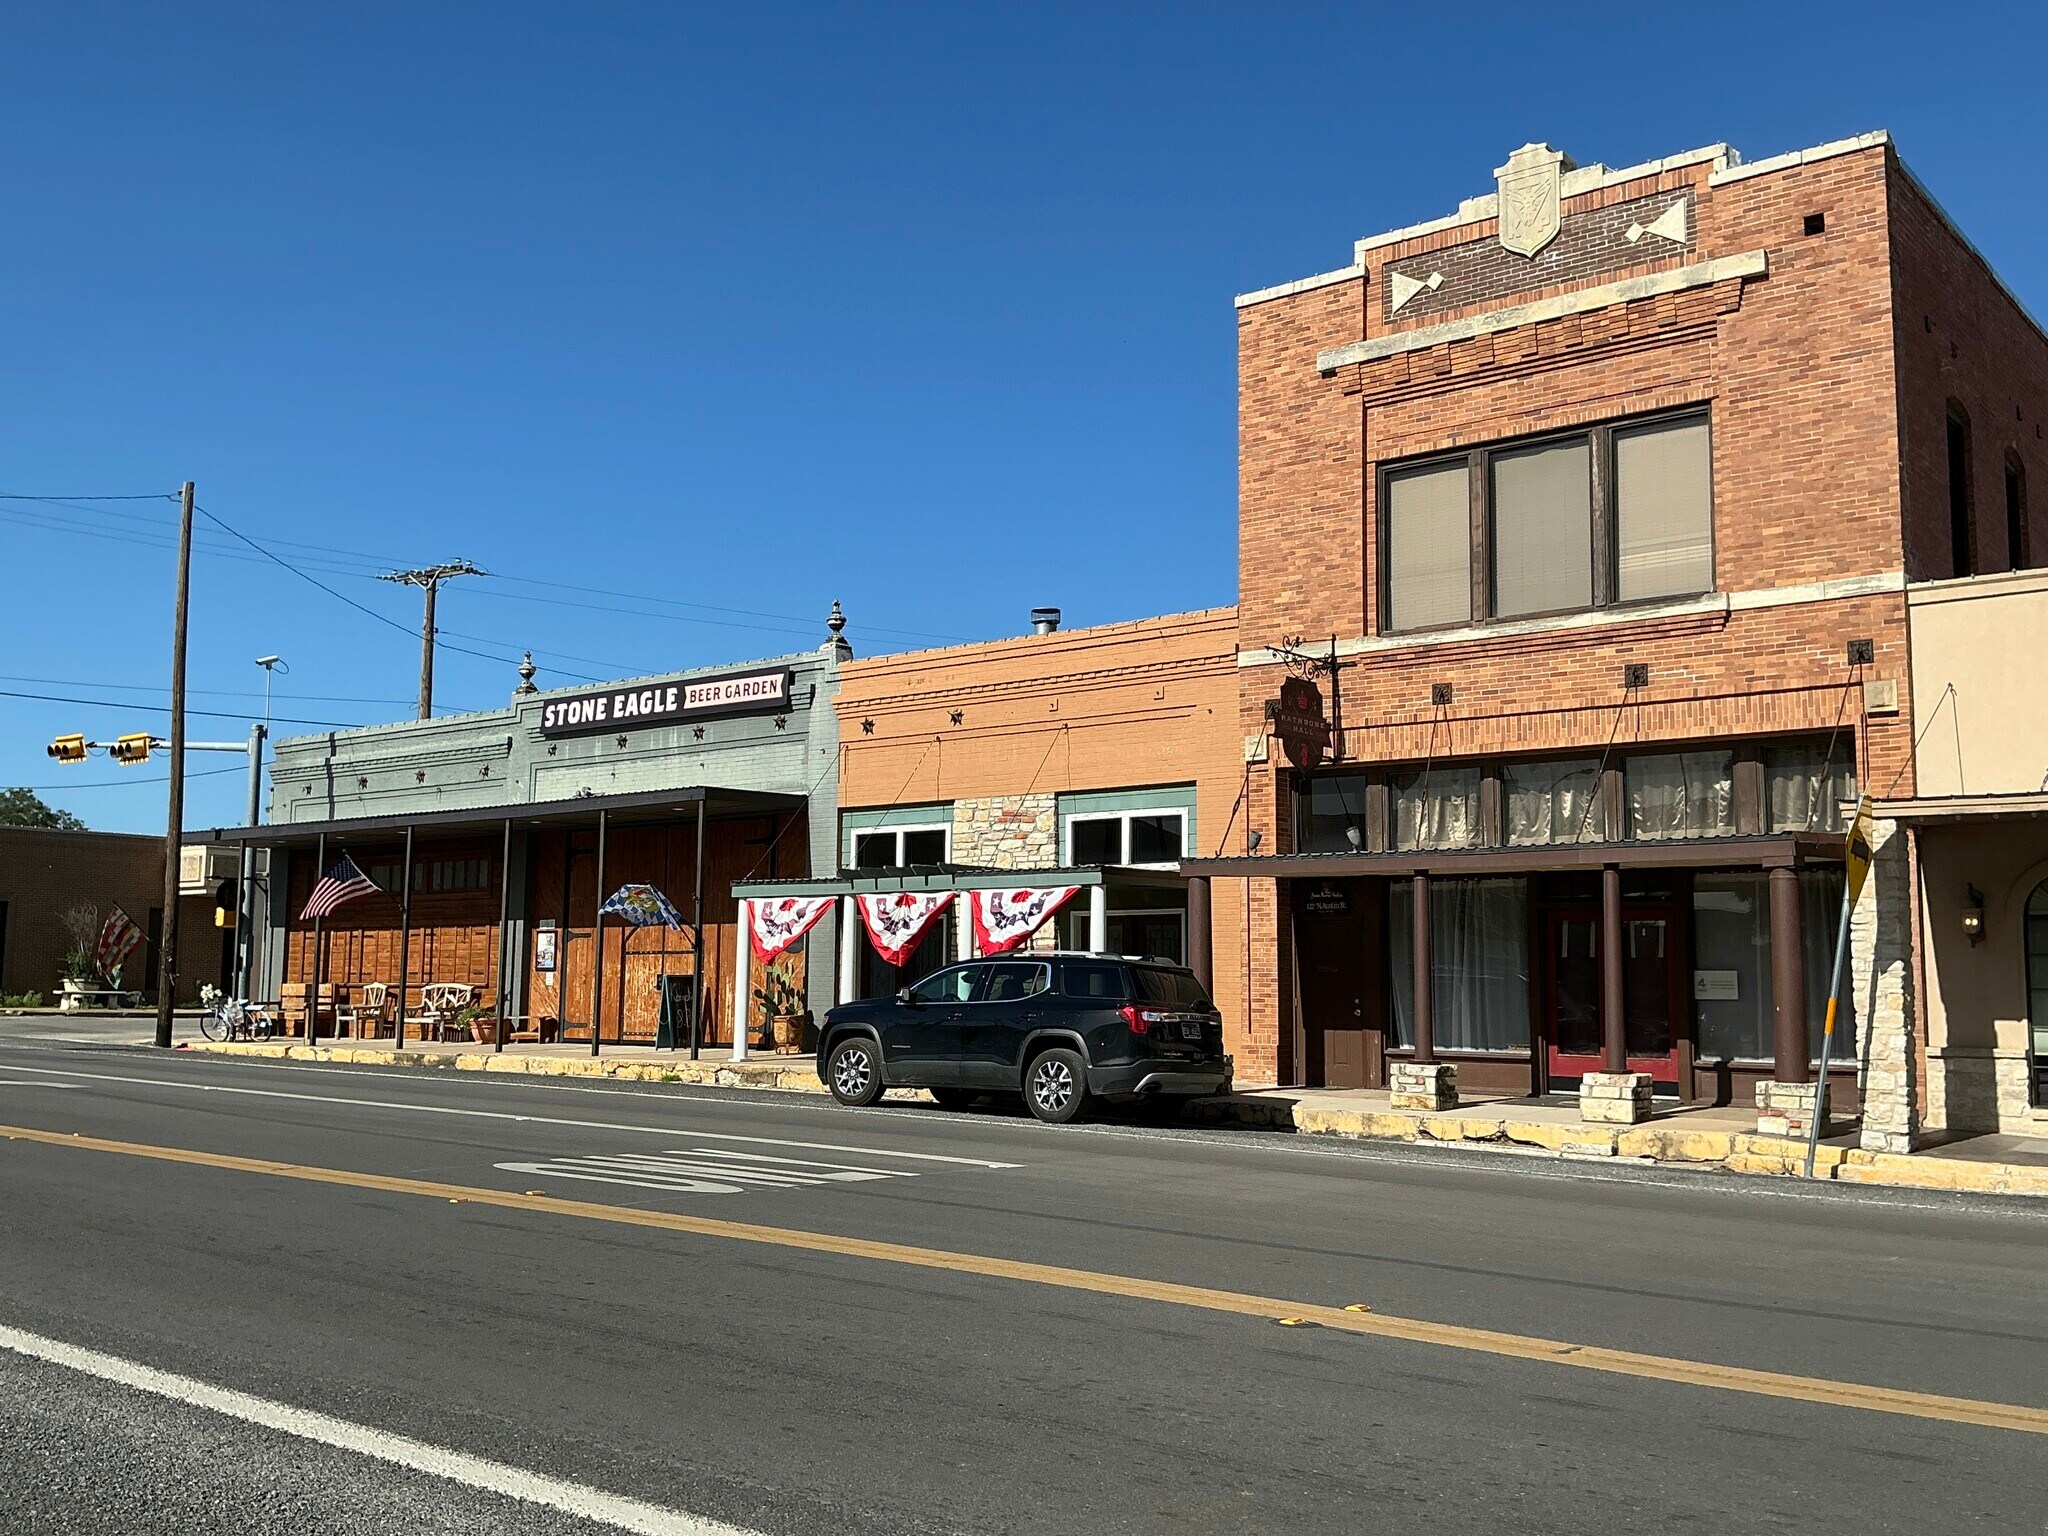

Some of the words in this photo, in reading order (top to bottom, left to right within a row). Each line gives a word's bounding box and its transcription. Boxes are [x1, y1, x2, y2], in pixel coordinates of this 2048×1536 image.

[689, 686, 720, 704] BEER
[725, 679, 778, 699] GARDEN
[544, 697, 607, 728] STONE
[613, 687, 678, 718] EAGLE
[1281, 714, 1325, 729] RATHBONE
[1293, 726, 1314, 736] HALL
[492, 1147, 922, 1194] ONLY
